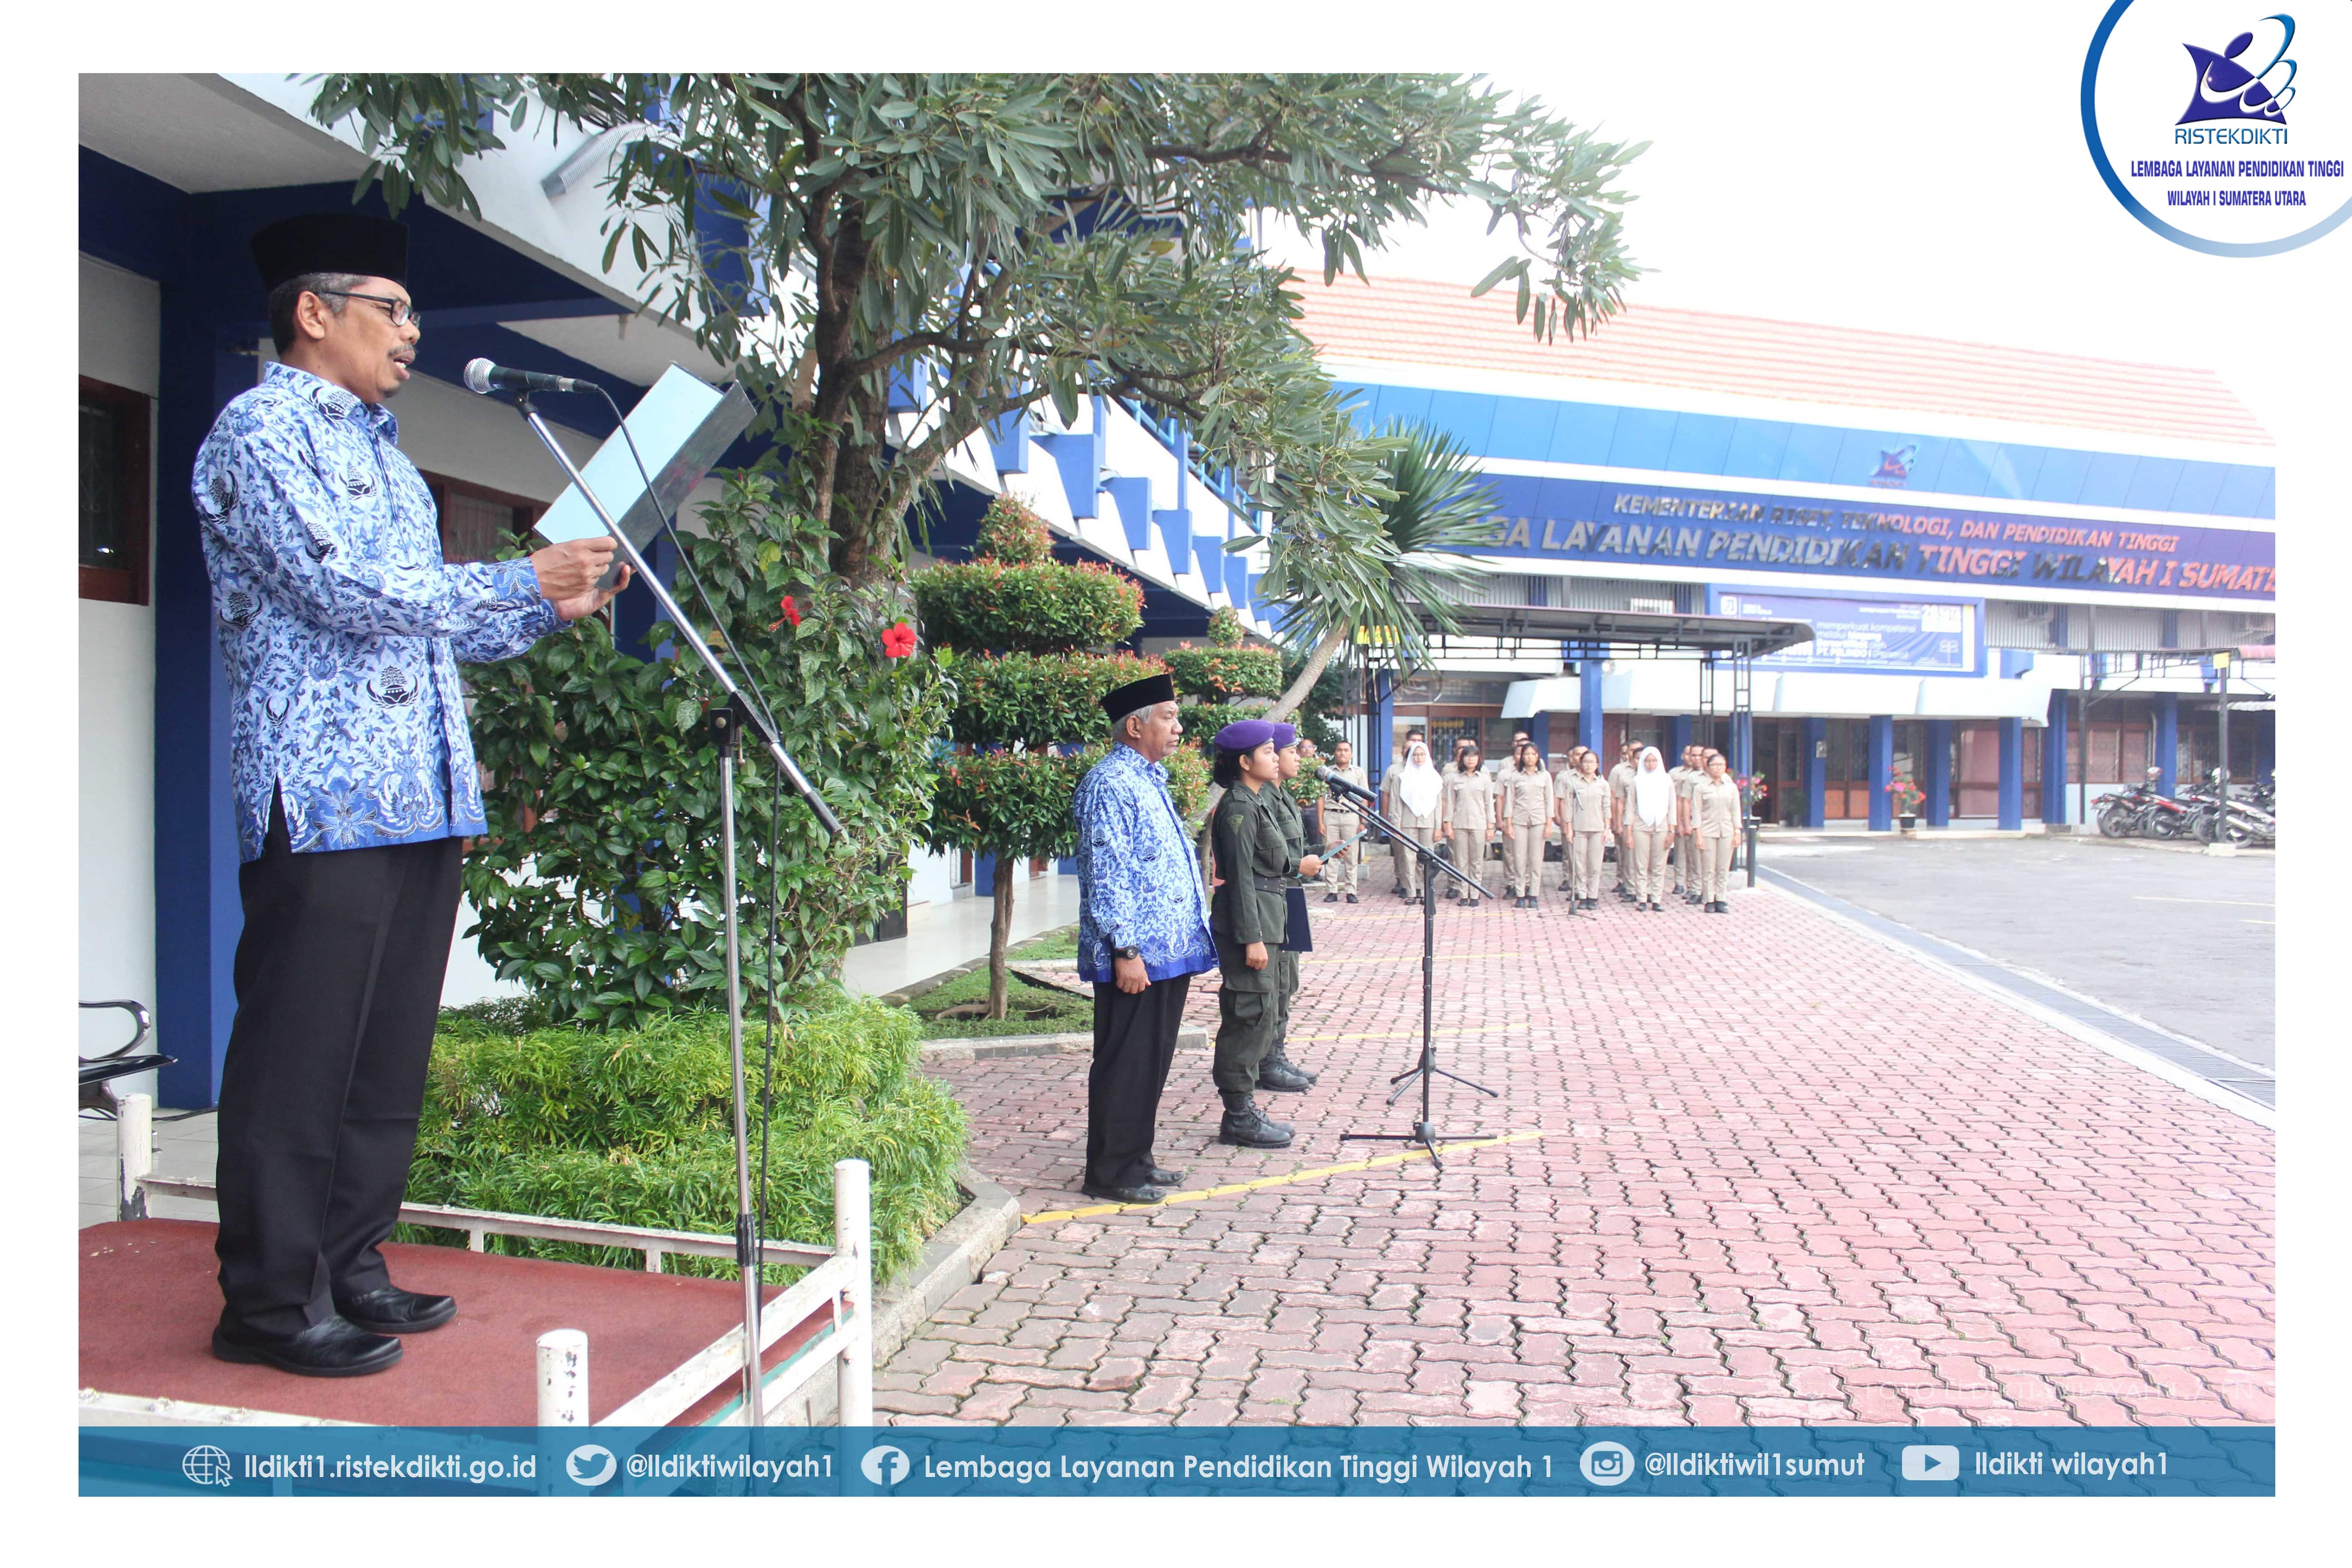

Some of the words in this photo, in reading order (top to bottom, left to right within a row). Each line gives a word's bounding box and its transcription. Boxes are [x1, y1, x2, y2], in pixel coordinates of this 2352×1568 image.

[1542, 519, 1702, 558] LAYANAN
[1706, 529, 1910, 571] PENDIDIKAN
[1917, 544, 2028, 578] TINGGI
[2032, 551, 2159, 586] WILAYAH
[2158, 560, 2177, 587] I
[1613, 493, 1765, 523] KEMENTERIAN
[1770, 505, 1833, 531] RISET,
[1841, 510, 1953, 540] TEKNOLOGI,
[1960, 519, 2000, 539] DAN
[2003, 523, 2113, 548] PENDIDIKAN
[2118, 532, 2180, 553] TINGGI
